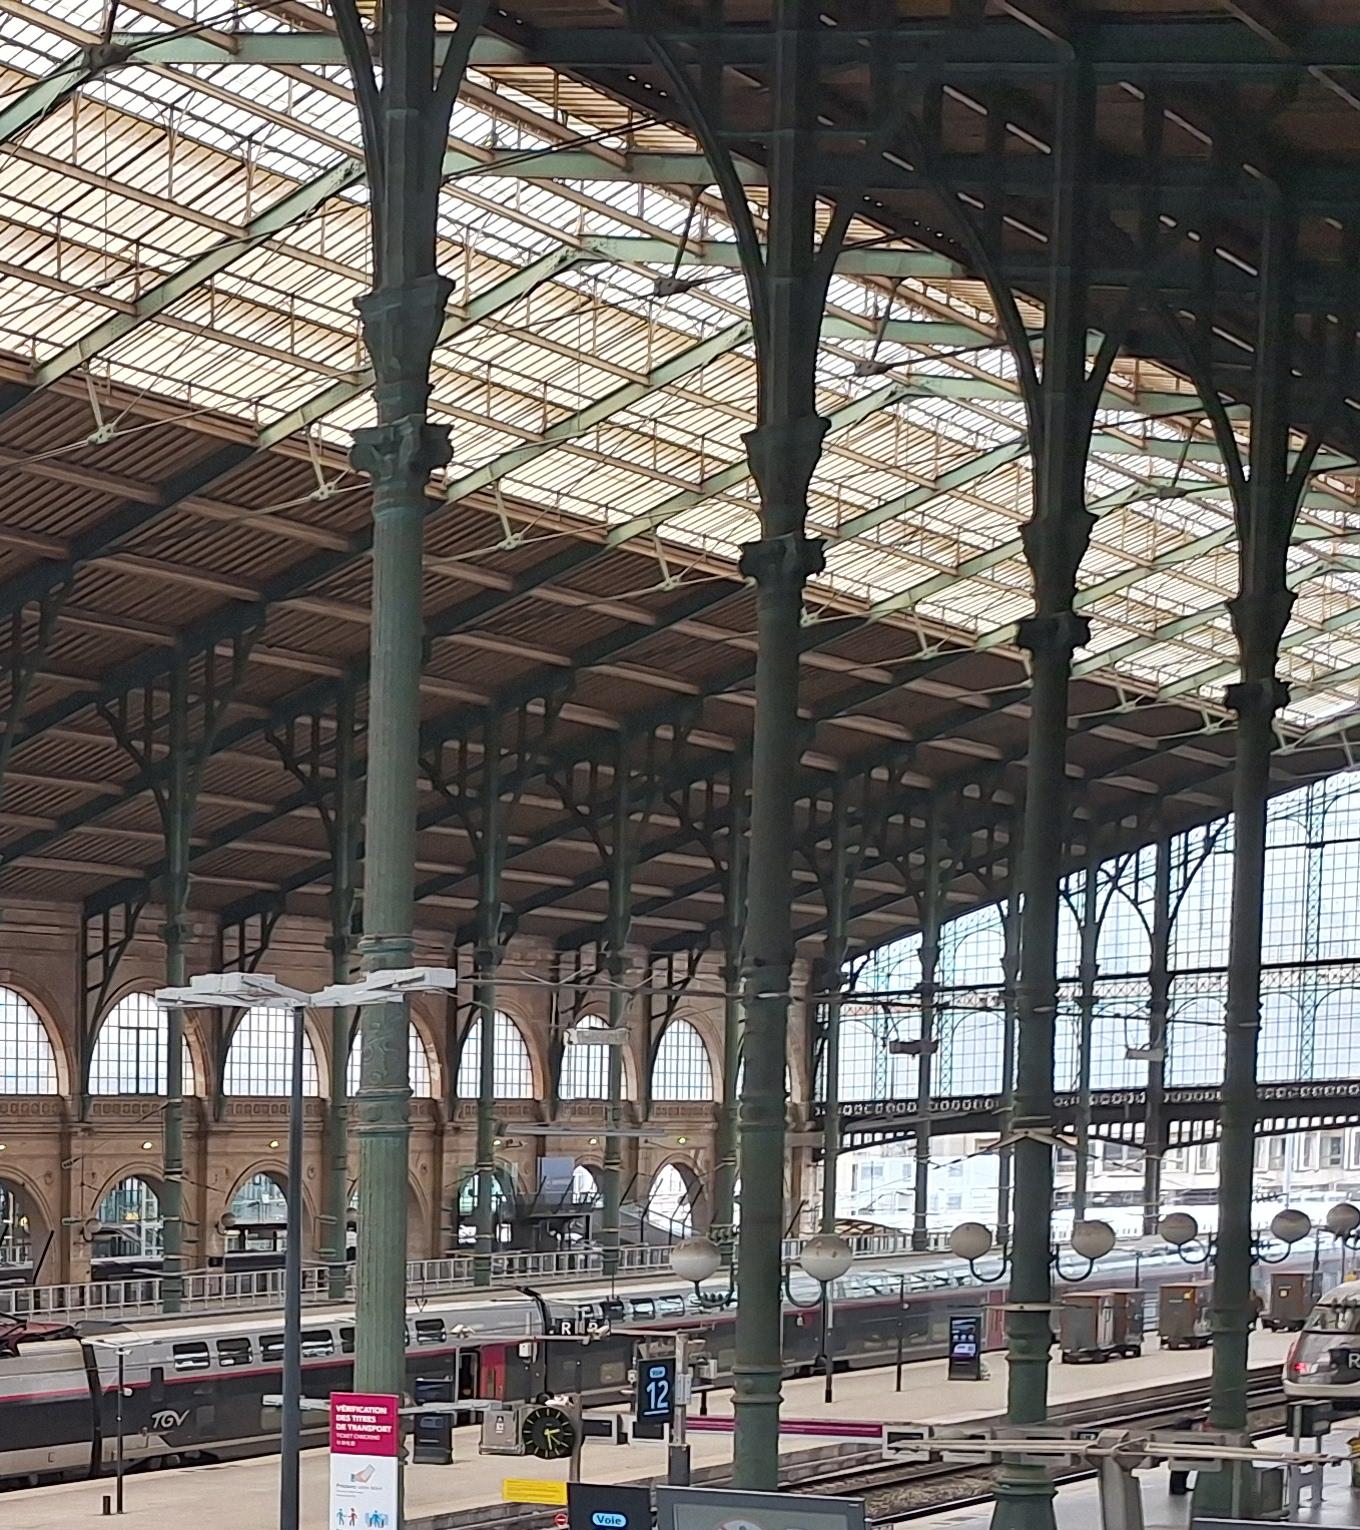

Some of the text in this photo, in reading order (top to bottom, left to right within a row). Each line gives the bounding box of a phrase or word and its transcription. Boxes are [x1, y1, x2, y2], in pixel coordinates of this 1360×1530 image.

[646, 1380, 669, 1410] 12
[151, 1409, 190, 1429] TGV
[596, 1514, 622, 1526] Voie
